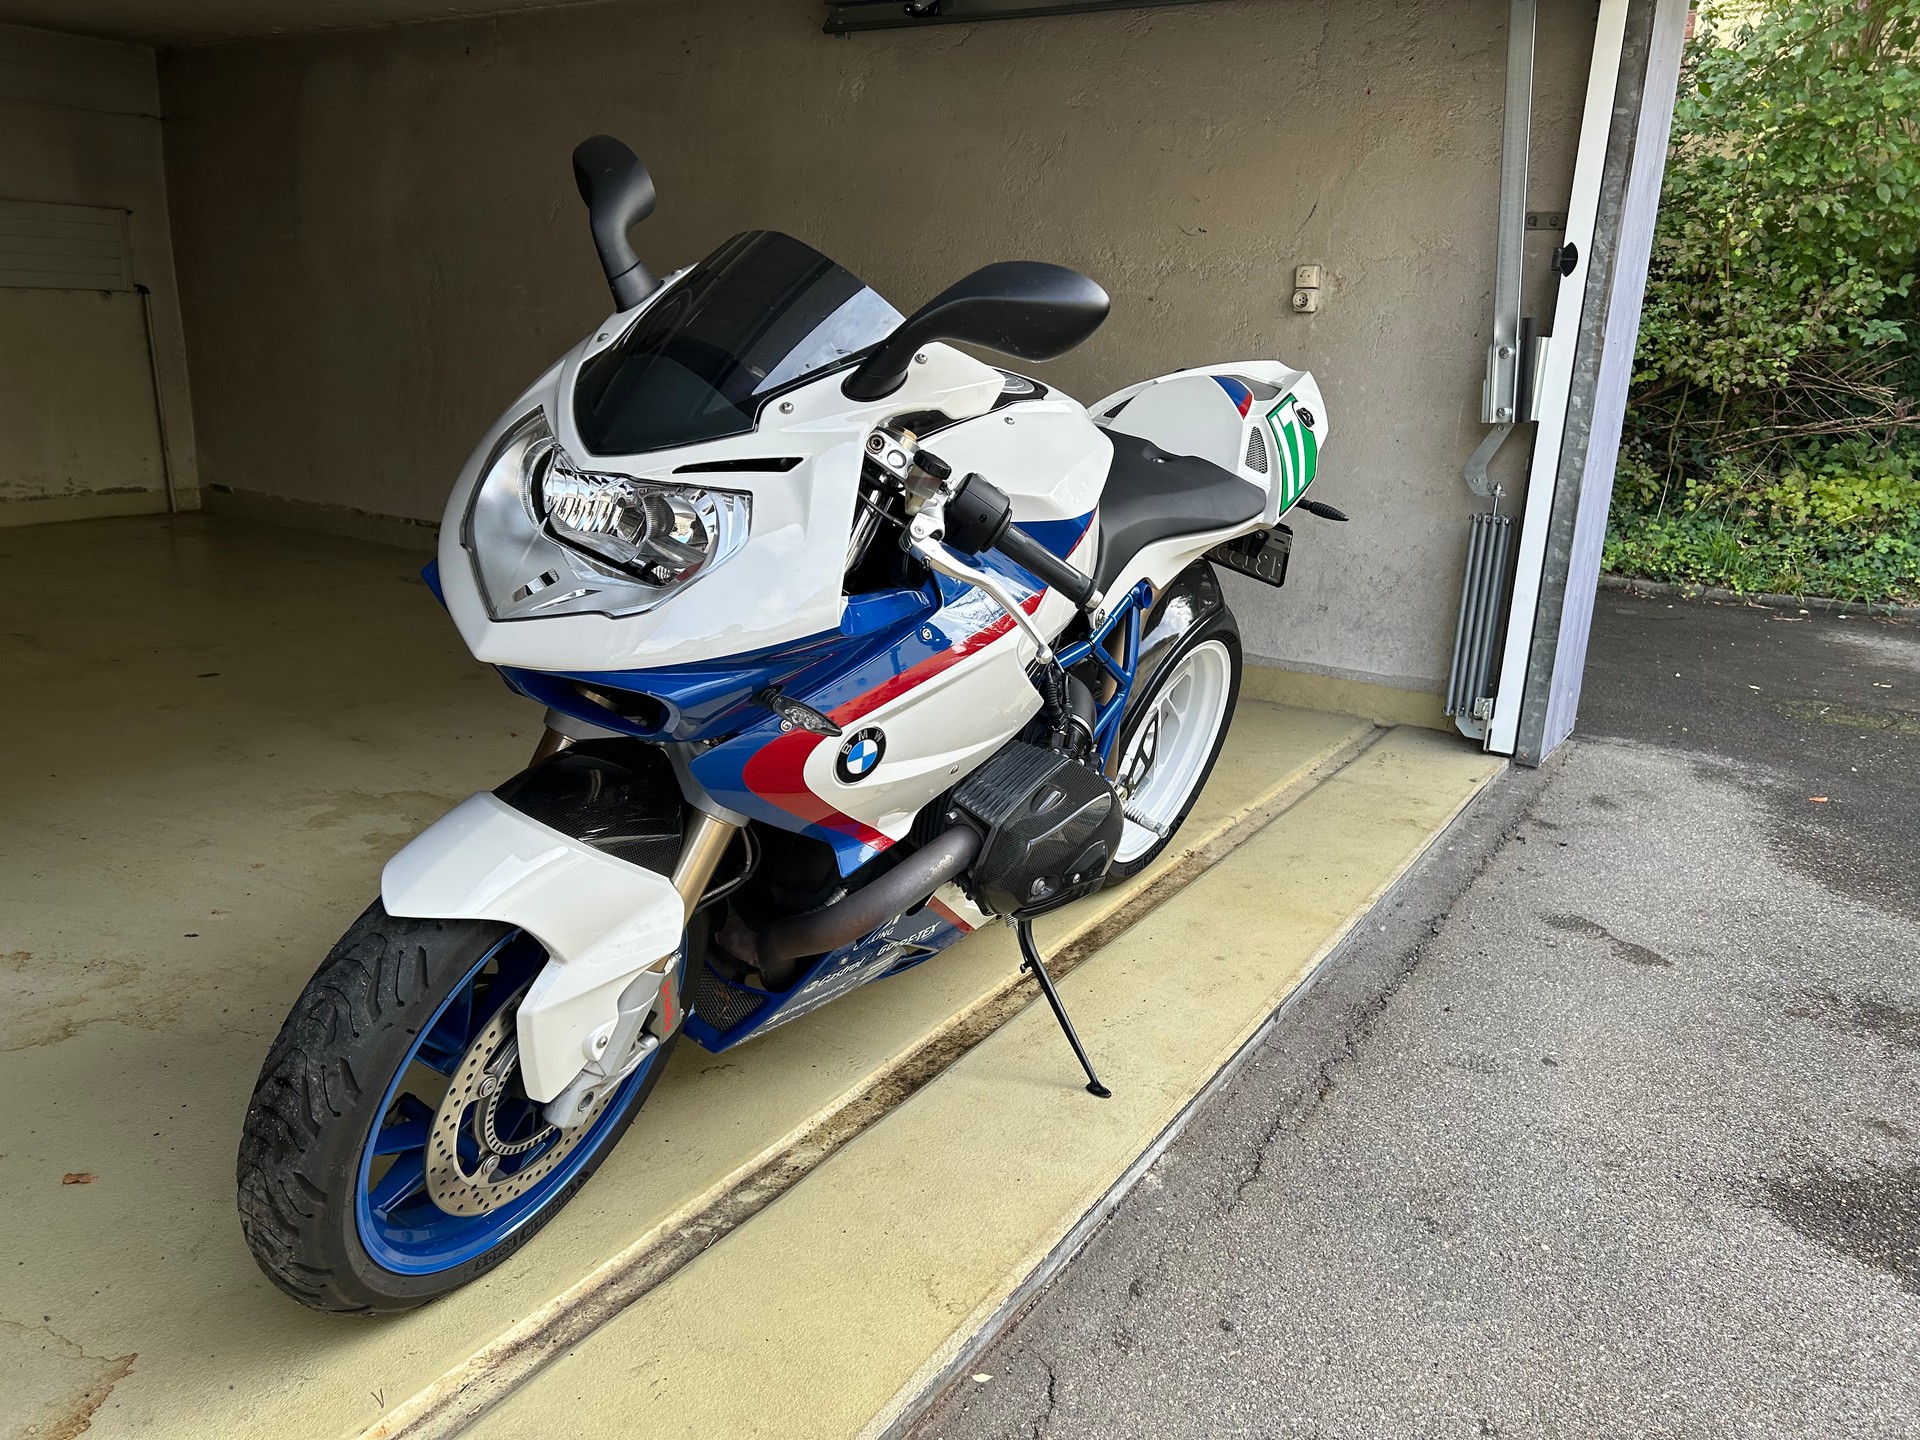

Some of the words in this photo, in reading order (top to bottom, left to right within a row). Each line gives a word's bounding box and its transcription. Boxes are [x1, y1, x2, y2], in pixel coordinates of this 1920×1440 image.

[1270, 400, 1306, 503] 17
[840, 728, 884, 755] BMW
[523, 1187, 573, 1238] MICHELIN
[477, 1258, 486, 1269] 6
[487, 1238, 514, 1263] ROAD
